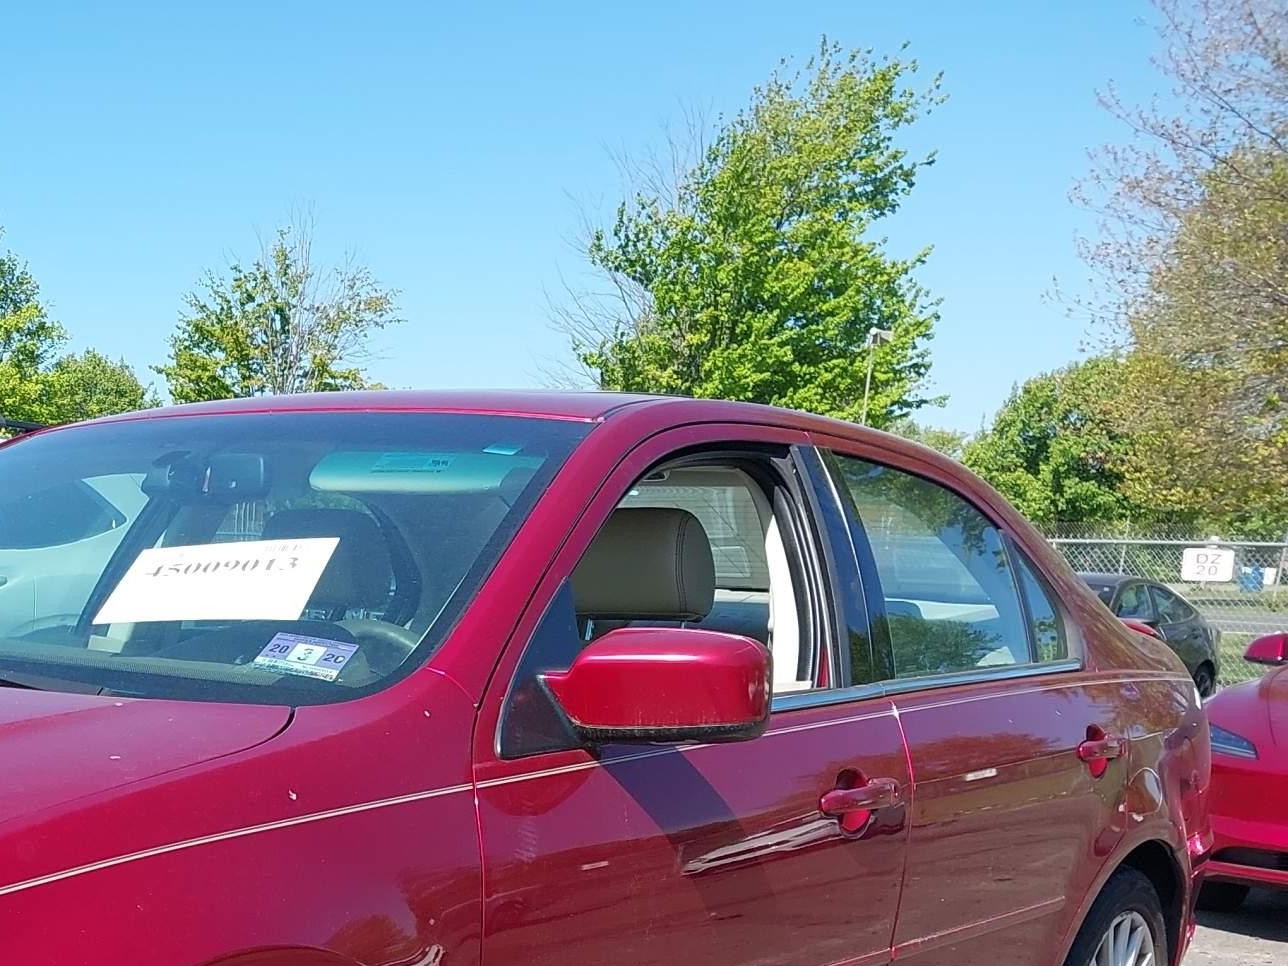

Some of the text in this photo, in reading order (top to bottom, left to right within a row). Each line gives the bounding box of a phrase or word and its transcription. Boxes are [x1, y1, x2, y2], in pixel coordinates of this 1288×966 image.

[1196, 553, 1222, 564] DZ
[1196, 565, 1218, 575] 20
[269, 643, 346, 664] 20 3 20
